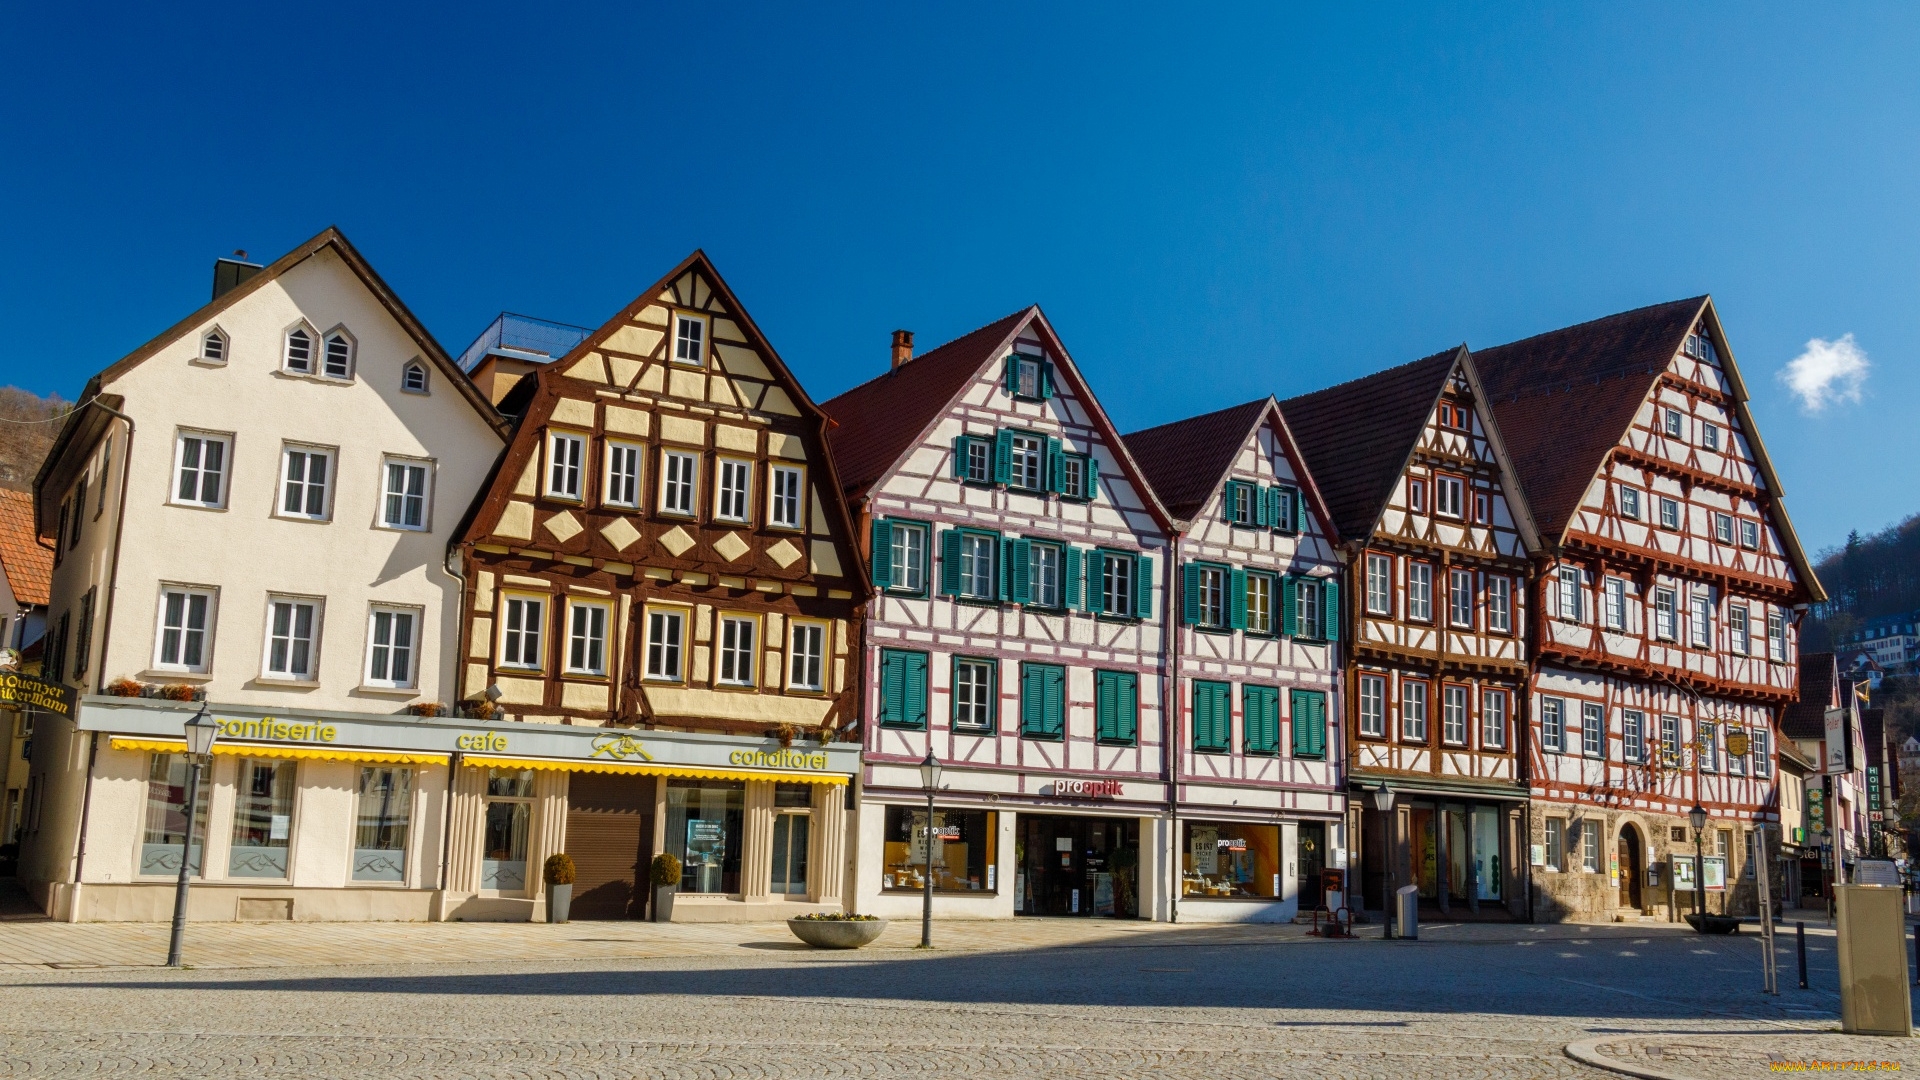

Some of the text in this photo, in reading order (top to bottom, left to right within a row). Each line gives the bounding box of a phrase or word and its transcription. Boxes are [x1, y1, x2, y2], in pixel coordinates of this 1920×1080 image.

[6, 675, 64, 698] Quenzer
[216, 717, 337, 742] confiserie
[459, 731, 508, 750] cafe
[731, 749, 829, 769] conditorei
[1054, 779, 1124, 798] prooptik
[1869, 767, 1878, 809] HOTEL
[923, 826, 960, 836] pooptik
